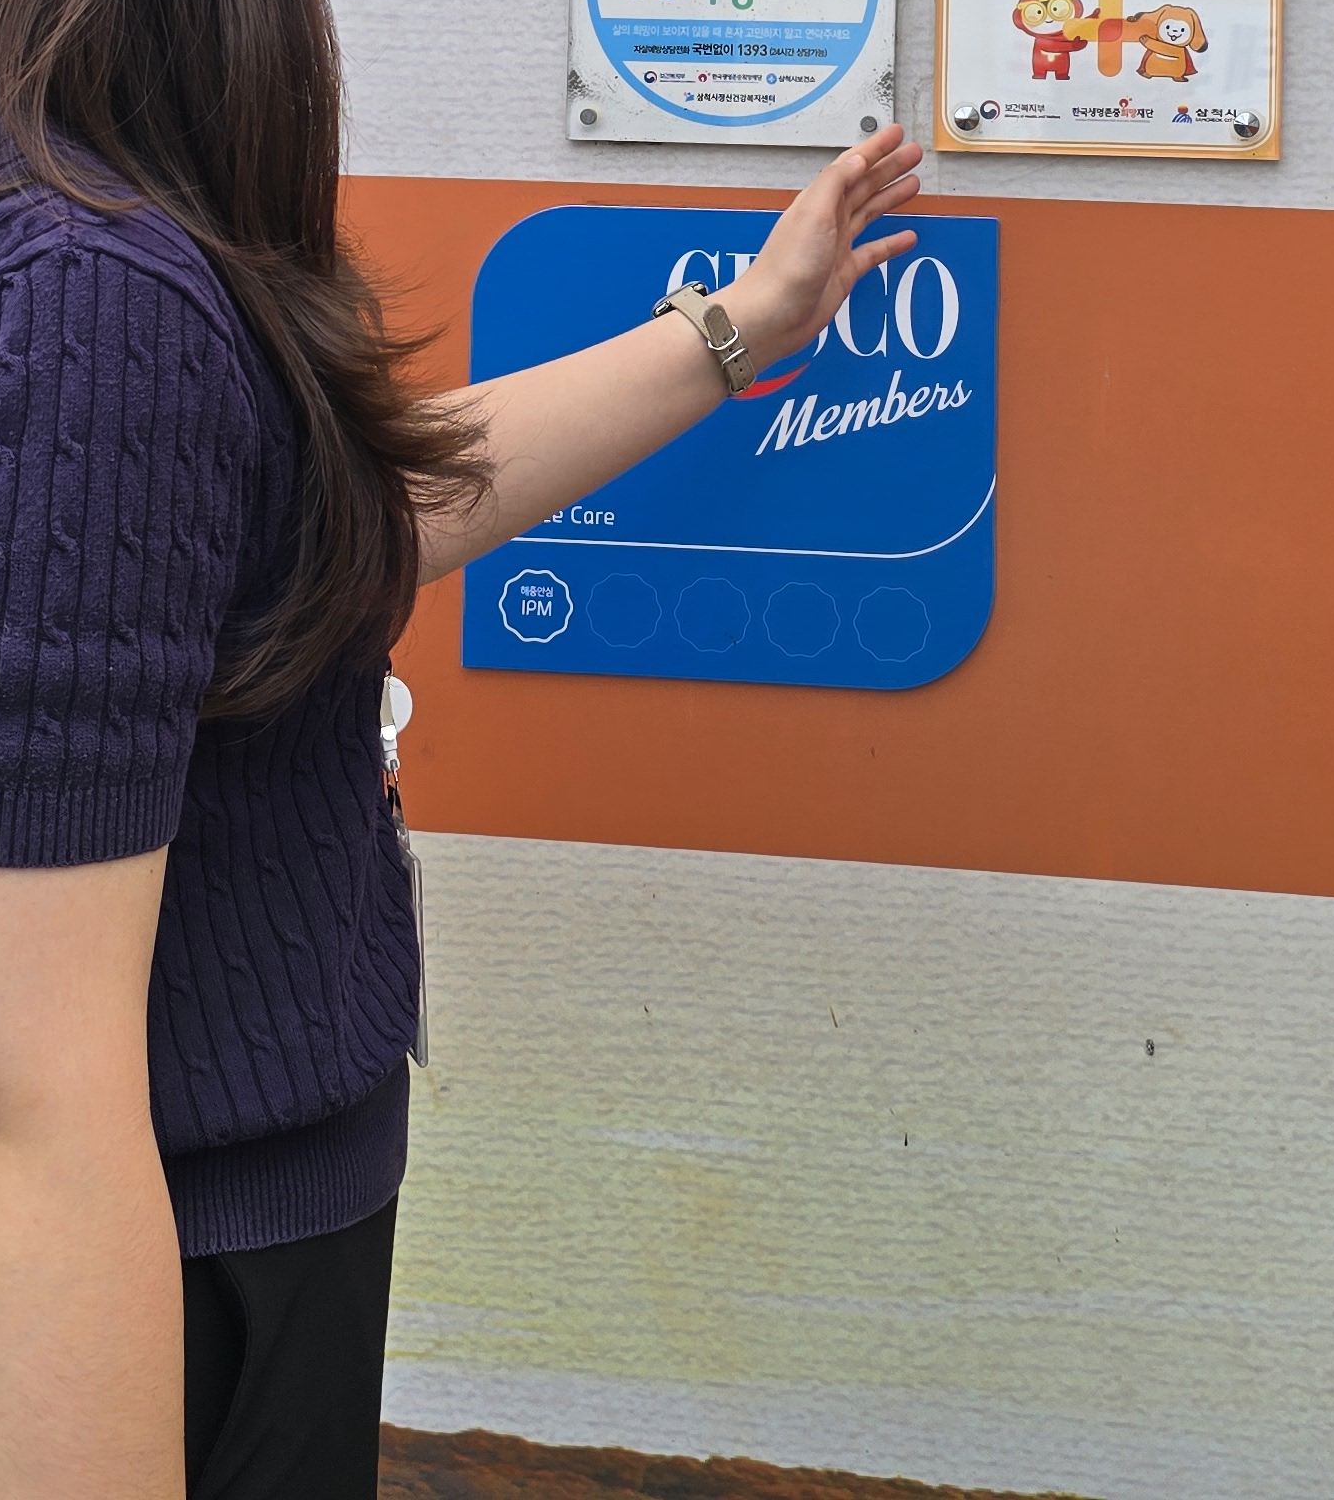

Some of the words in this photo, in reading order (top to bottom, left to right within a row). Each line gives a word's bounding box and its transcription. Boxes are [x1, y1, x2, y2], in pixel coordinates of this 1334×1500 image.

[632, 25, 660, 37] 희망이
[661, 25, 690, 38] 보이지
[724, 26, 744, 38] 혼자
[745, 26, 781, 39] 고민하지
[805, 27, 851, 40] 연락주세요
[691, 42, 734, 57] 국번없이
[737, 43, 768, 57] 1393
[769, 46, 795, 57] (24시간
[796, 47, 828, 58] 상담가능)
[1004, 103, 1046, 113] 보건복지부
[1195, 107, 1238, 119] 삼척시
[755, 369, 973, 456] Members
[570, 505, 615, 526] Care
[521, 599, 553, 617] IPM
